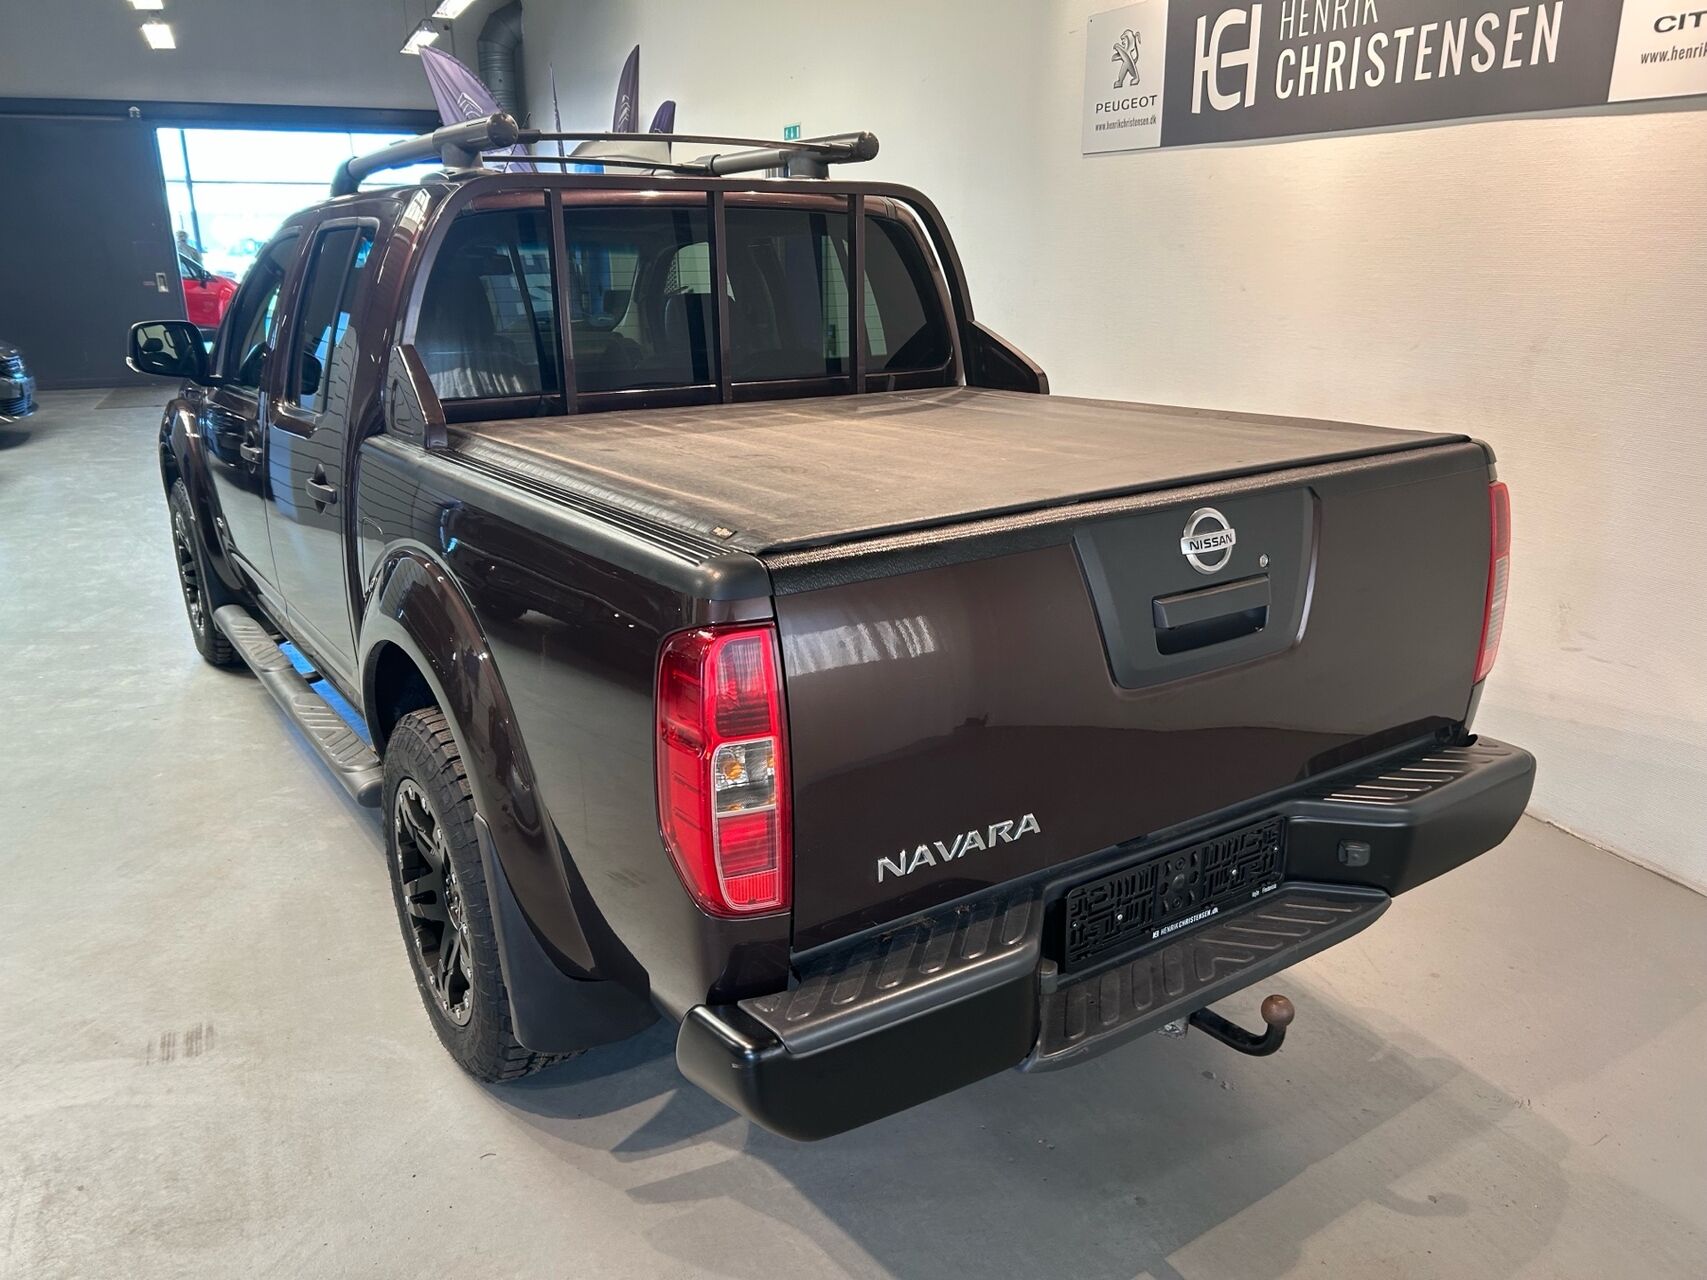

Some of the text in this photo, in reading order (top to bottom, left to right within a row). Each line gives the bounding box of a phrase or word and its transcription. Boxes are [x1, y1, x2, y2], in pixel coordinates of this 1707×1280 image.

[1279, 0, 1379, 41] HENRIK
[1275, 0, 1564, 100] CHRISTENSEN
[1095, 94, 1158, 114] PEUGEOT
[1095, 115, 1157, 131] www.henrikchristensen.dk
[1189, 533, 1234, 551] NISSAN
[877, 812, 1041, 884] NAVARA
